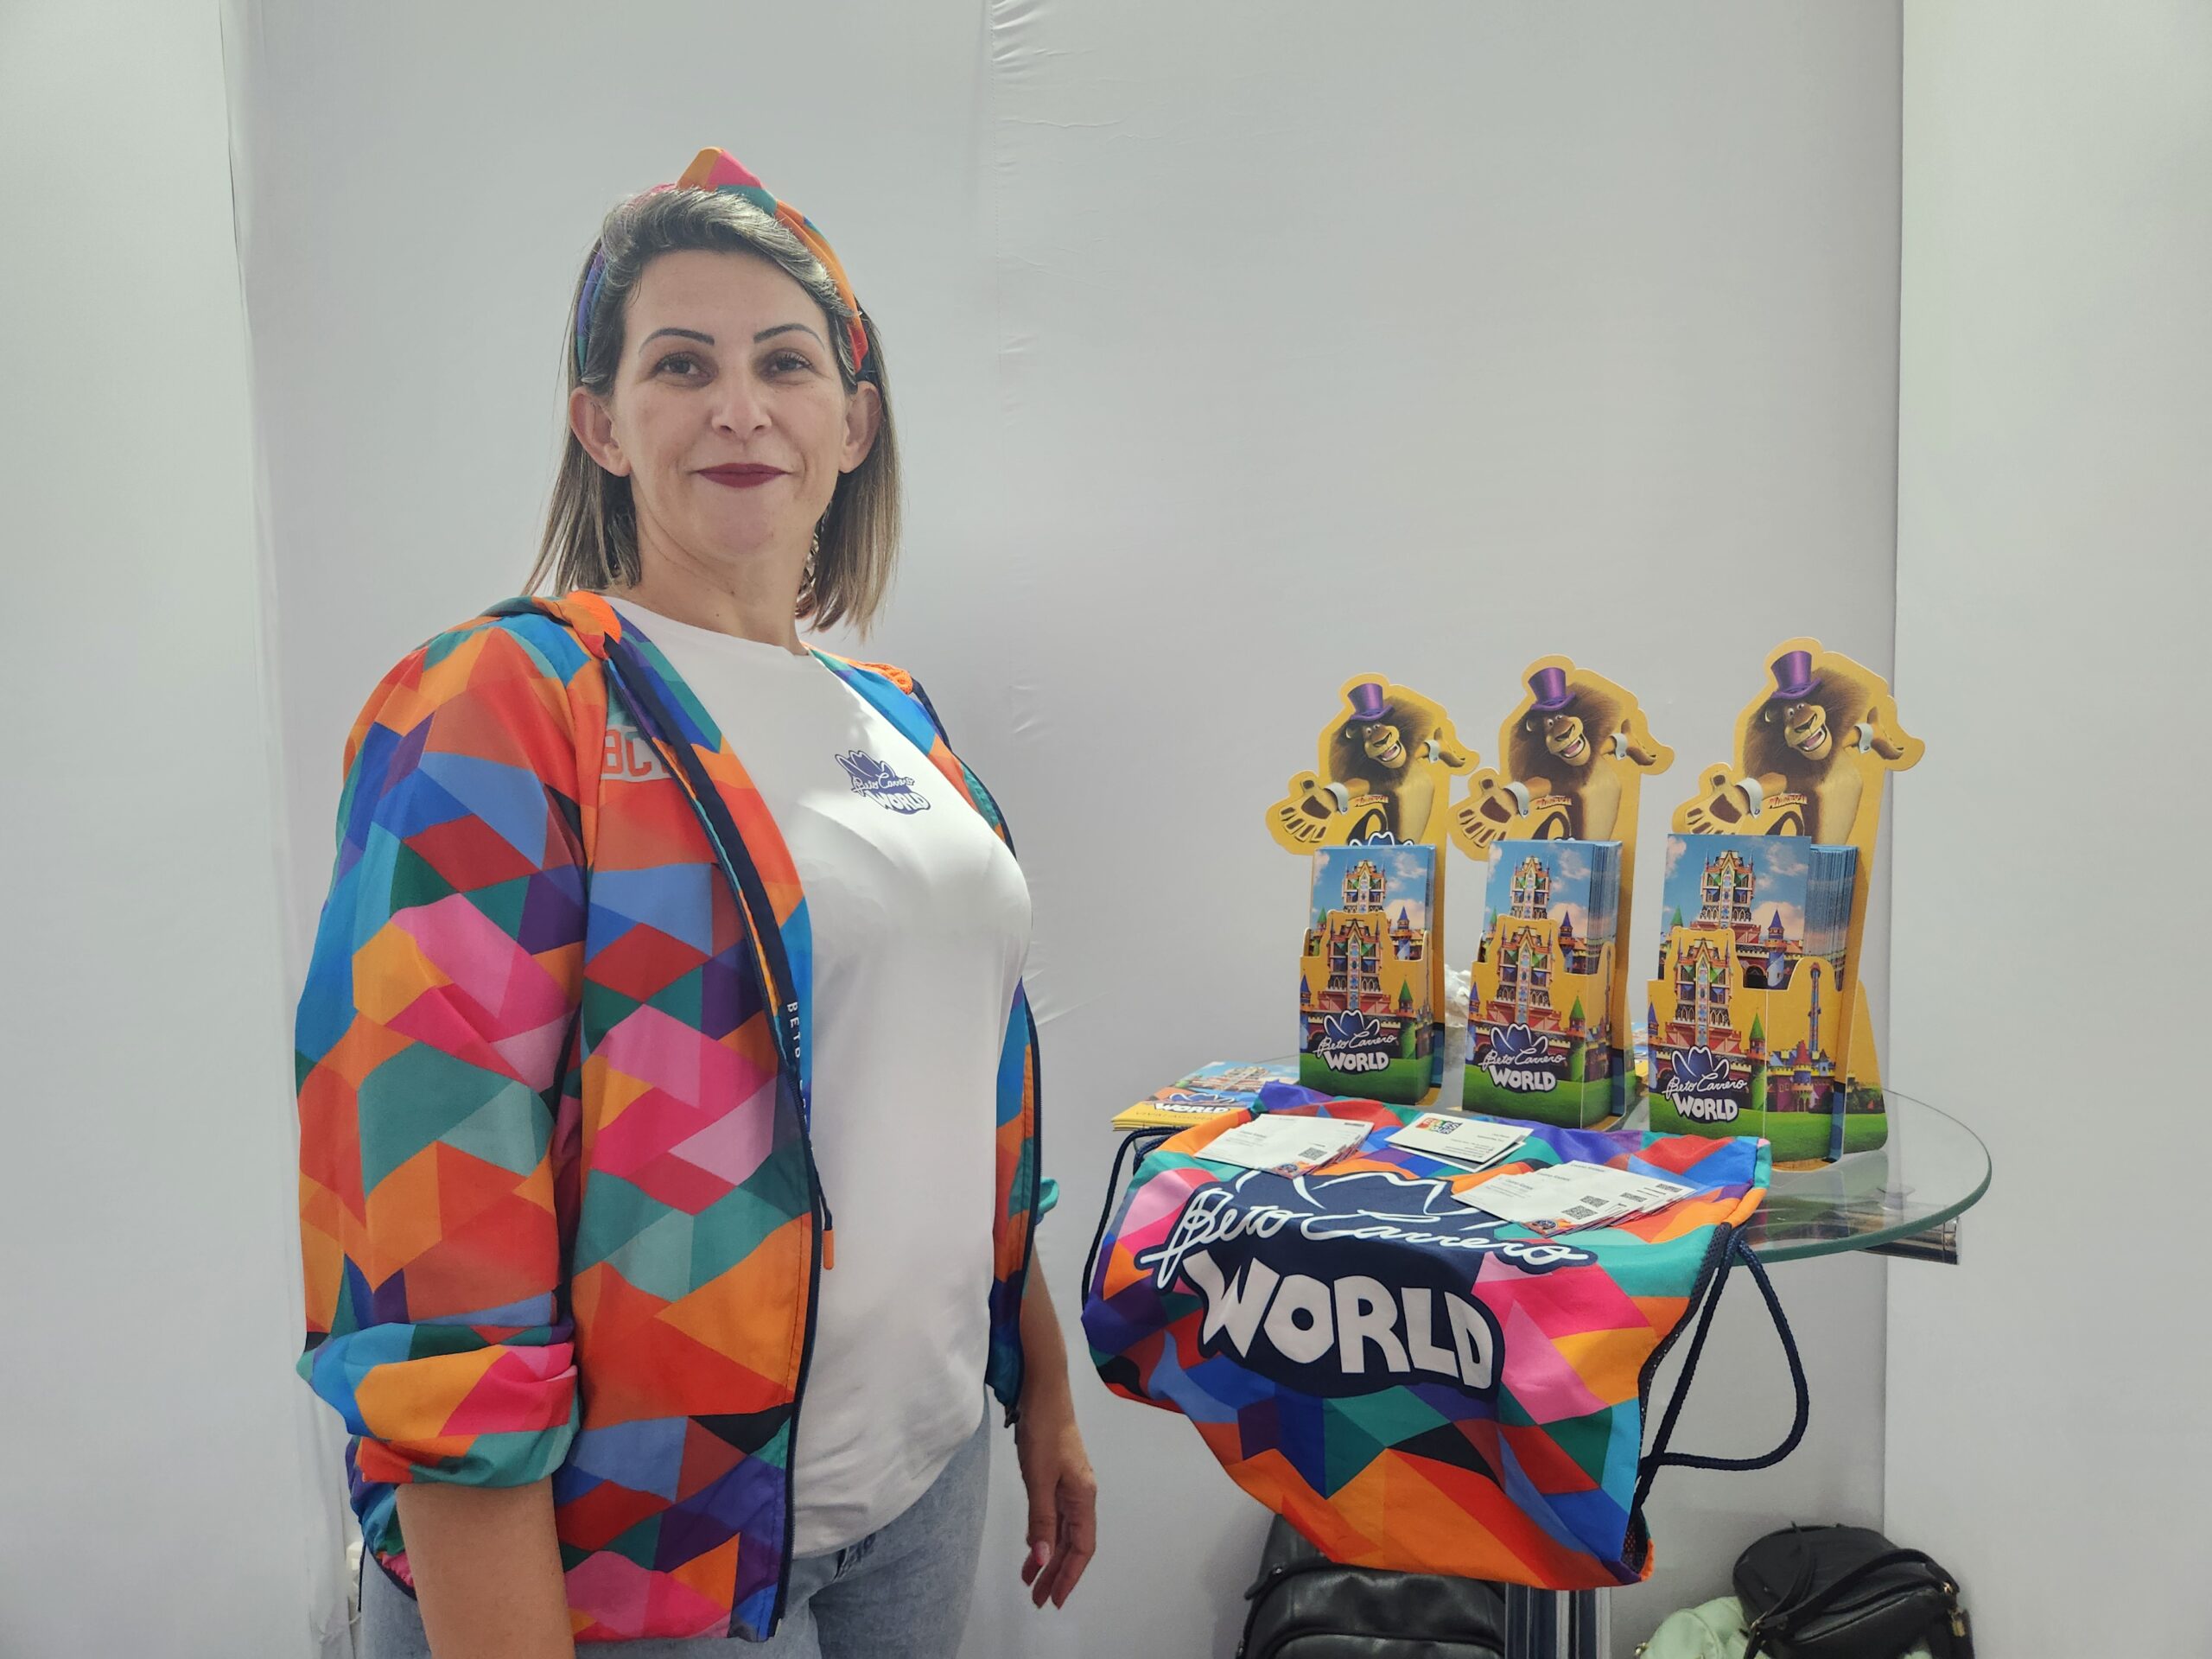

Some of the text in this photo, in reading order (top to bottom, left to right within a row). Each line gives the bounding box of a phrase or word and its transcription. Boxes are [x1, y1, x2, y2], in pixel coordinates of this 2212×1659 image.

[604, 729, 667, 777] BC
[865, 790, 930, 811] WORLD
[787, 1001, 802, 1058] BETO
[1313, 1031, 1396, 1058] Beto Carrero
[1324, 1051, 1389, 1071] WORLD
[1478, 1047, 1566, 1071] Beto Carrero
[1488, 1065, 1555, 1090] WORLD
[1662, 1072, 1747, 1099] Beto Carrero
[1154, 1103, 1229, 1113] WORLD
[1672, 1092, 1738, 1121] WORLD
[1140, 1187, 1588, 1288] Beto Carrero
[1183, 1249, 1493, 1389] WORLD
